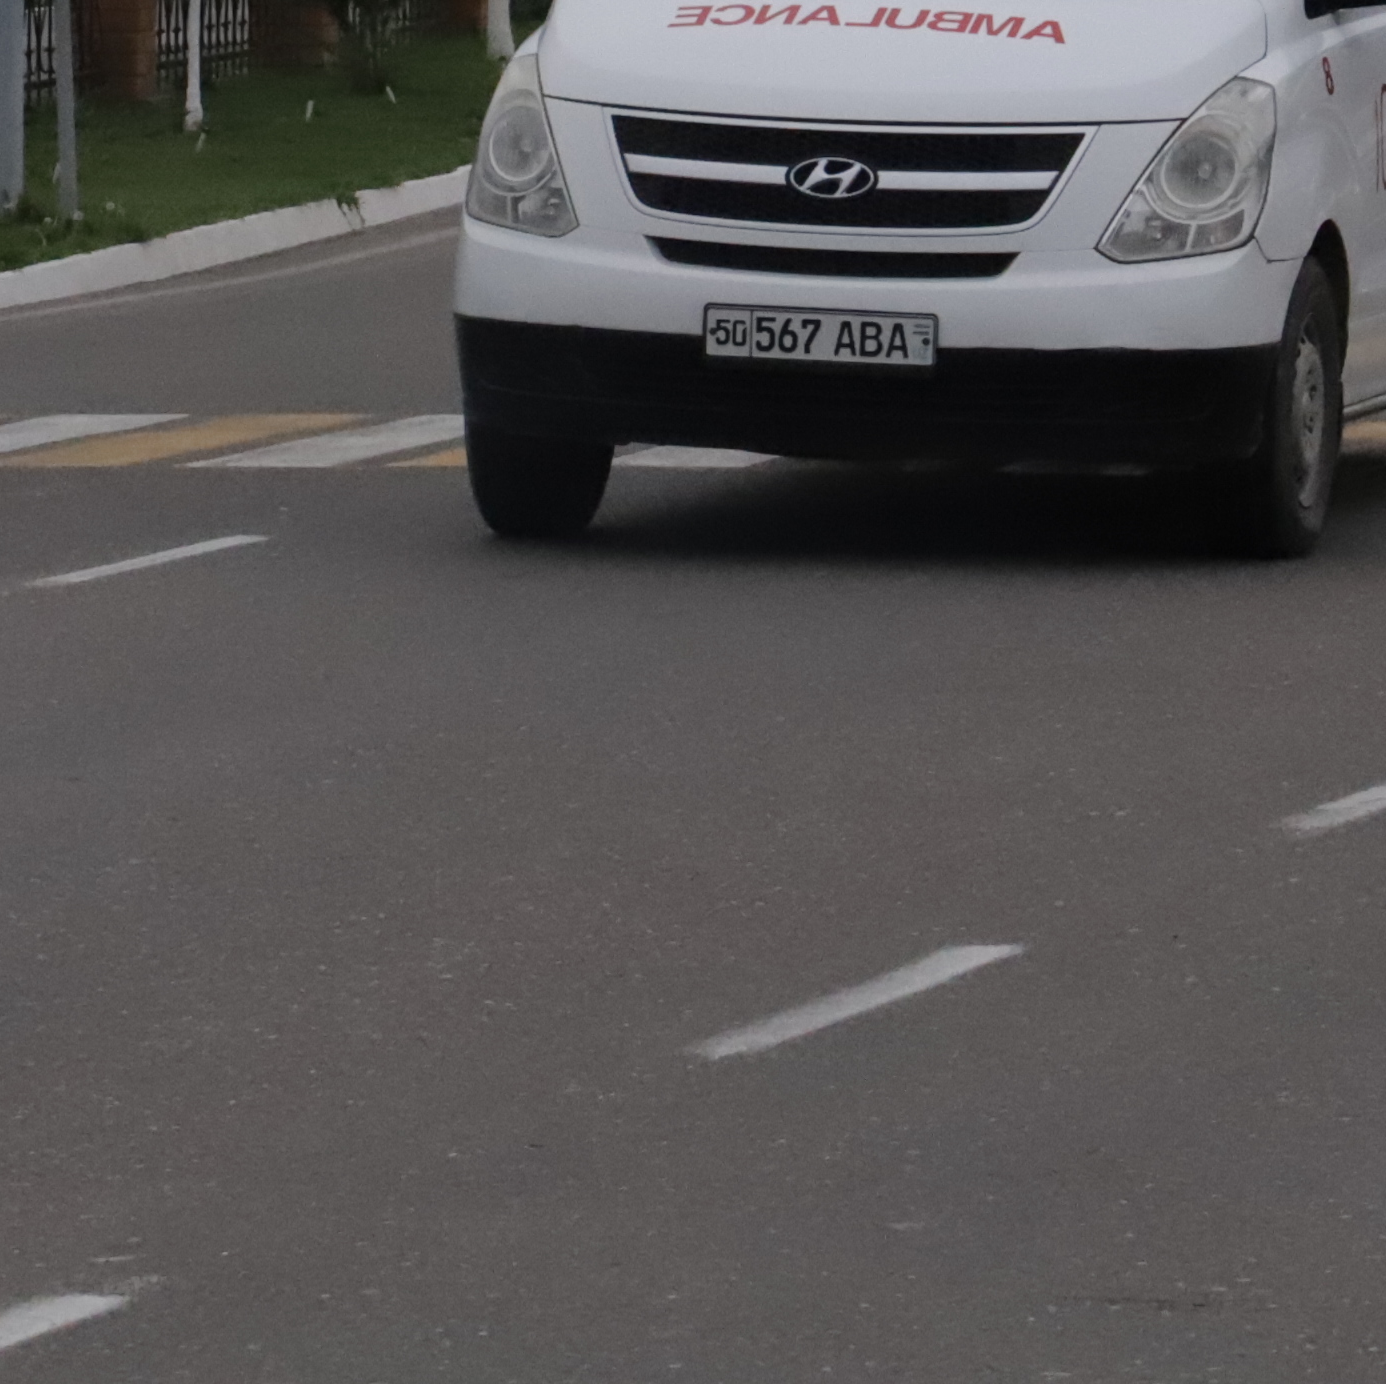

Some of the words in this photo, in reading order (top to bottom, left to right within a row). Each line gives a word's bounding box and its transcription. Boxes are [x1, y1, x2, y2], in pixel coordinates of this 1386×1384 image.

[1322, 56, 1335, 96] 8
[715, 319, 748, 347] 50
[755, 316, 822, 354] 567
[834, 320, 910, 359] ABA
